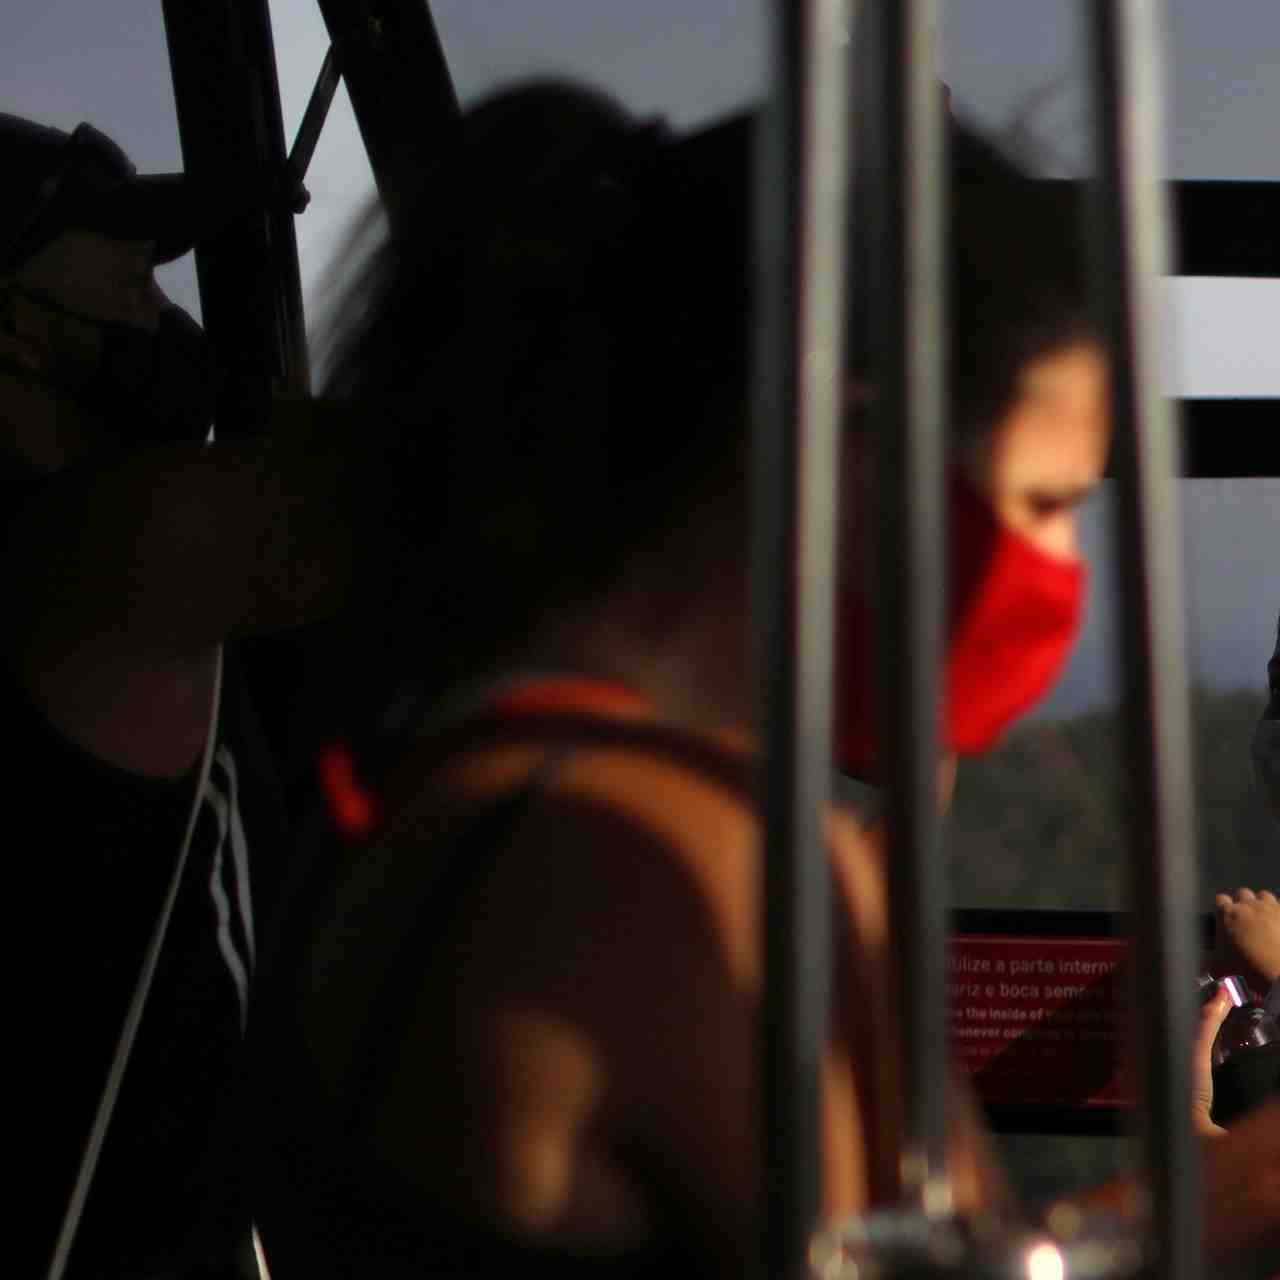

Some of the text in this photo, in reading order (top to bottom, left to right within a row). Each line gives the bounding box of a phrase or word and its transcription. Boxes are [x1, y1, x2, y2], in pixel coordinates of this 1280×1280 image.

[995, 960, 1006, 974] a
[1009, 959, 1055, 976] parte
[984, 985, 996, 998] e
[1000, 979, 1040, 999] boca
[965, 1006, 988, 1019] the
[988, 1006, 1027, 1021] inside
[1029, 1007, 1044, 1021] of
